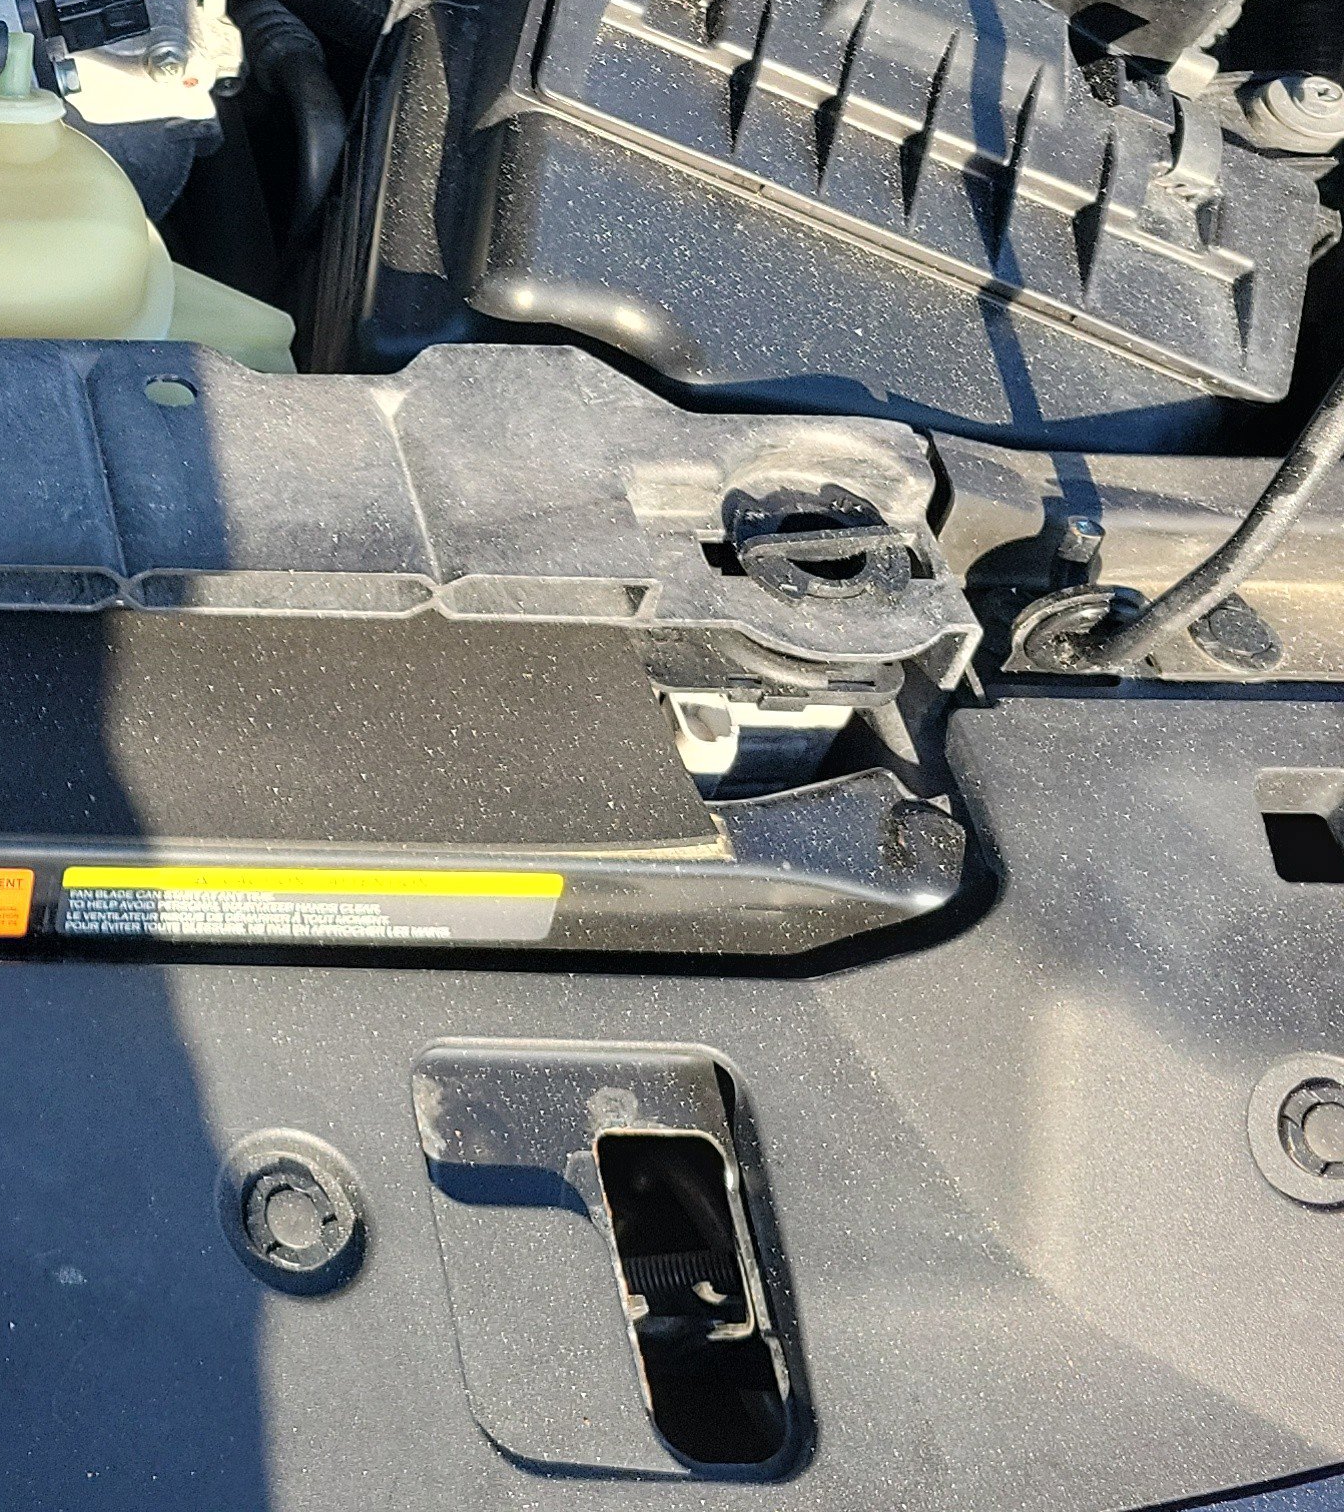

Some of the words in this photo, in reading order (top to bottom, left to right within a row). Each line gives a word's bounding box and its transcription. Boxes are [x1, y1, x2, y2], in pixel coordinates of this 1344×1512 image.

[70, 890, 94, 900] FAN
[95, 890, 133, 900] BLADE
[135, 890, 162, 900] CAN
[69, 900, 85, 910] TO
[86, 900, 117, 910] HELP
[118, 900, 154, 910] AVOID
[66, 911, 82, 920] LE
[83, 911, 158, 922] VENTILATEUR
[207, 913, 224, 922] DE
[65, 922, 100, 932] POUR
[102, 920, 142, 933] ÉVITER
[143, 922, 180, 933] TOUTE
